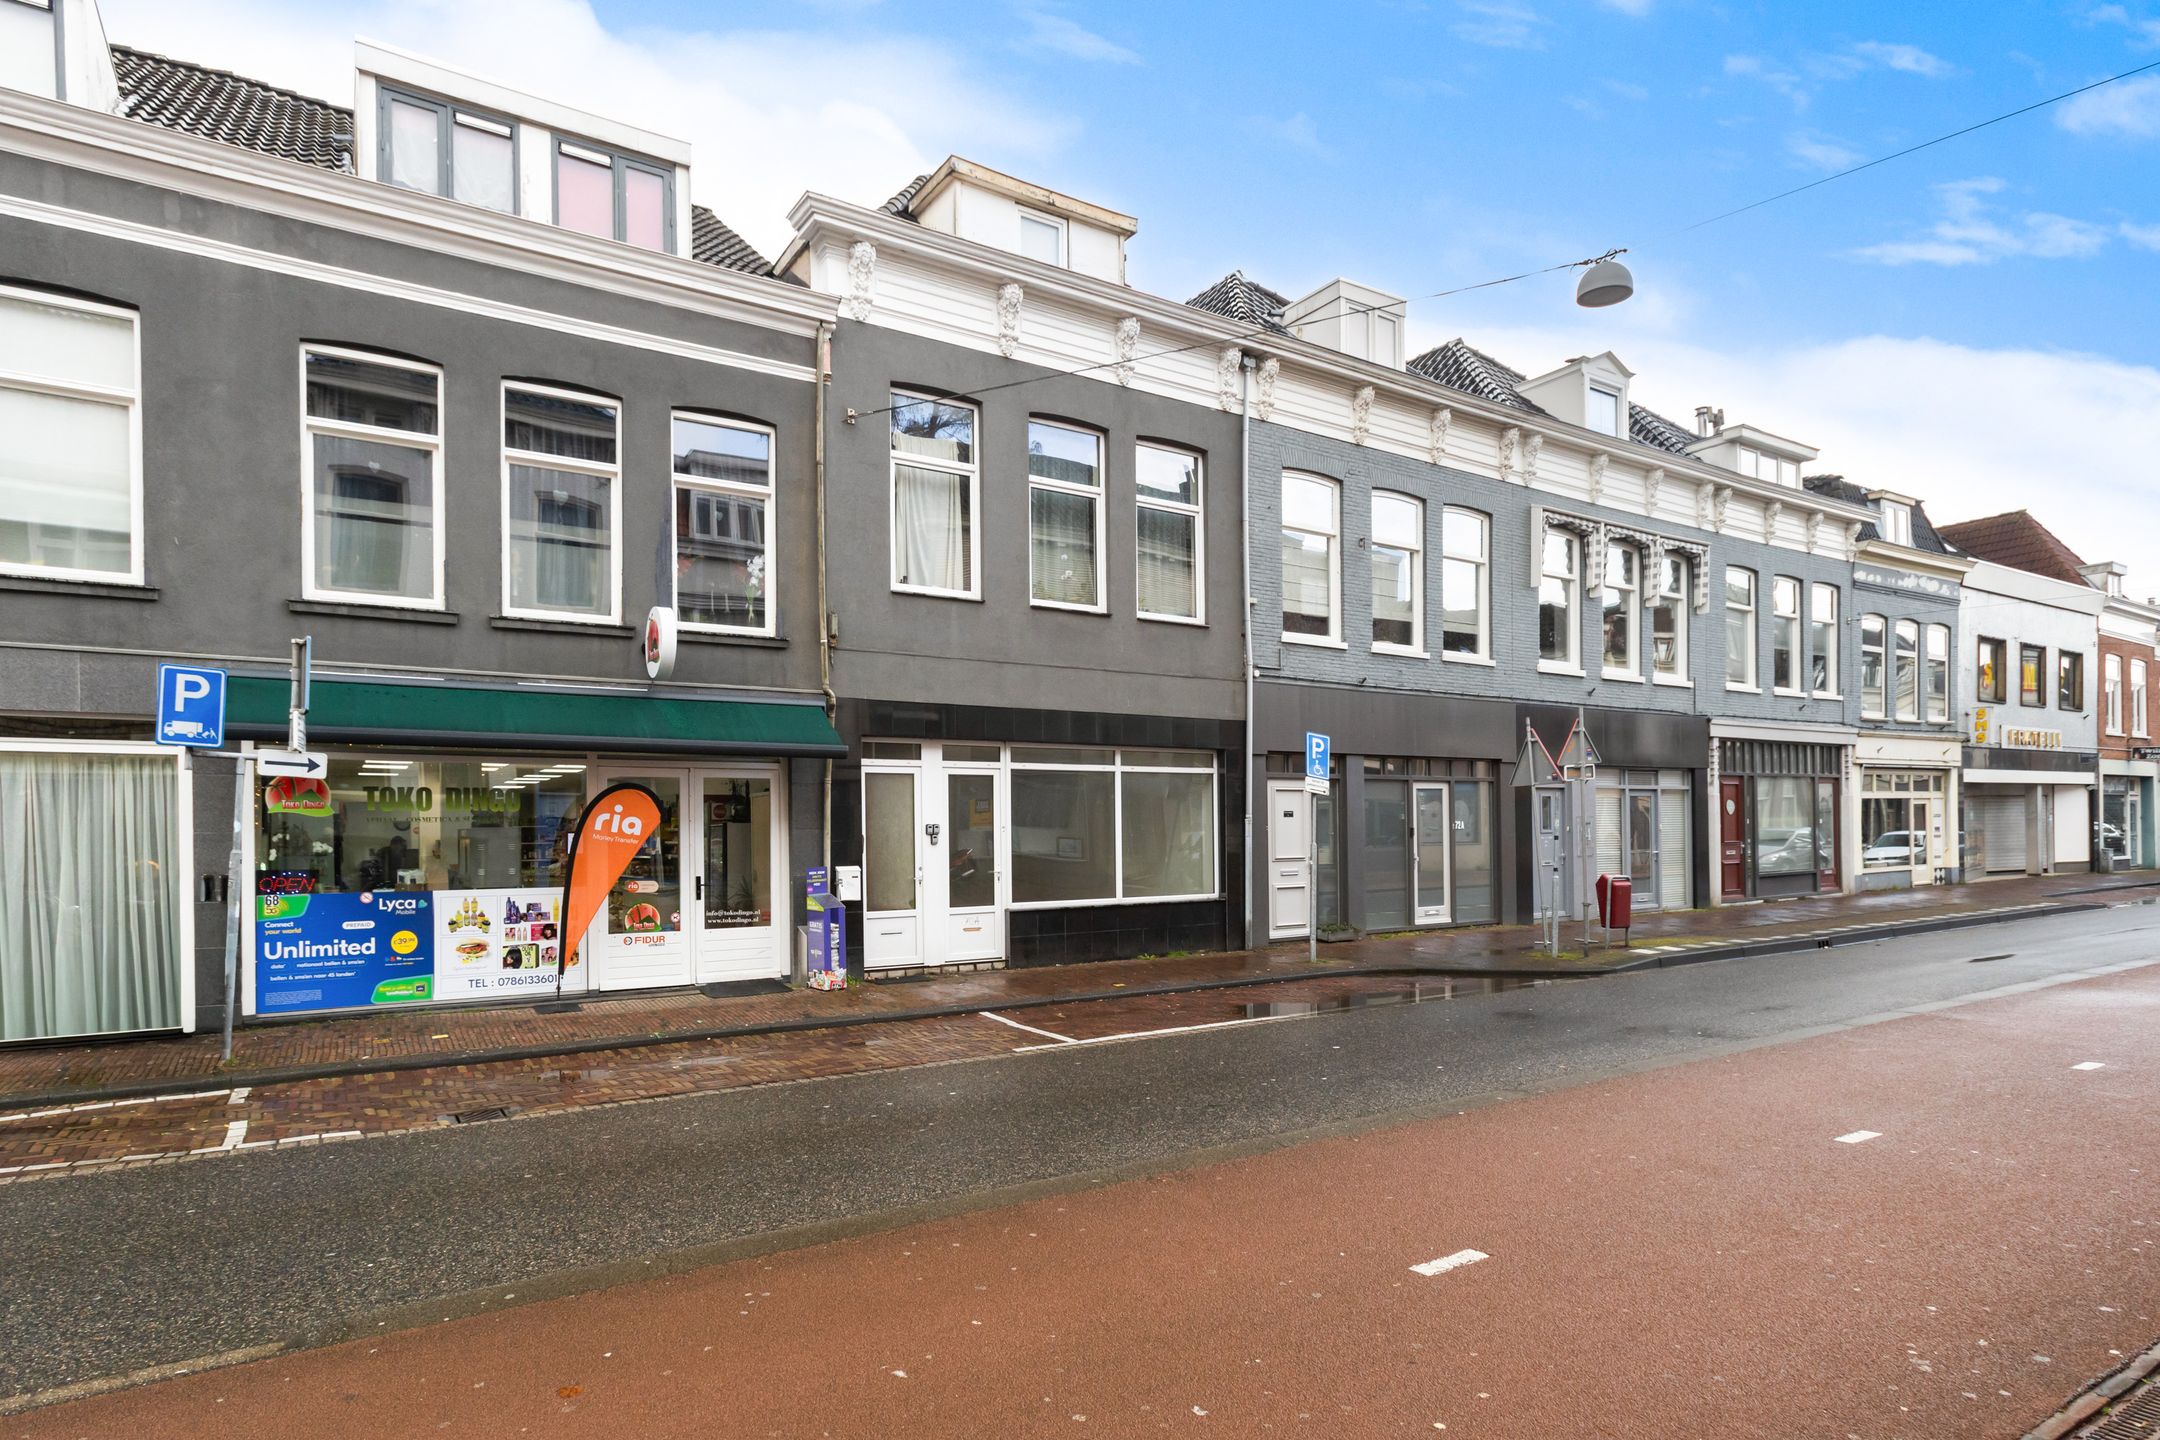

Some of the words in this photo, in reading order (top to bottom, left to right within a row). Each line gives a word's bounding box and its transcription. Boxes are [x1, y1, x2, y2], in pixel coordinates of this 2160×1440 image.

[174, 673, 211, 712] P
[1312, 737, 1325, 759] P
[363, 786, 433, 812] TOKO
[445, 787, 521, 813] DINGO
[594, 804, 642, 836] ria
[592, 833, 614, 842] Money
[615, 836, 639, 844] Transfer
[259, 877, 316, 892] OPEN
[265, 895, 280, 906] 68
[378, 897, 417, 912] Lyca
[634, 936, 666, 944] FIDUR
[264, 937, 376, 960] Unlimited
[468, 979, 489, 988] TEL
[497, 974, 559, 986] 0786133601
